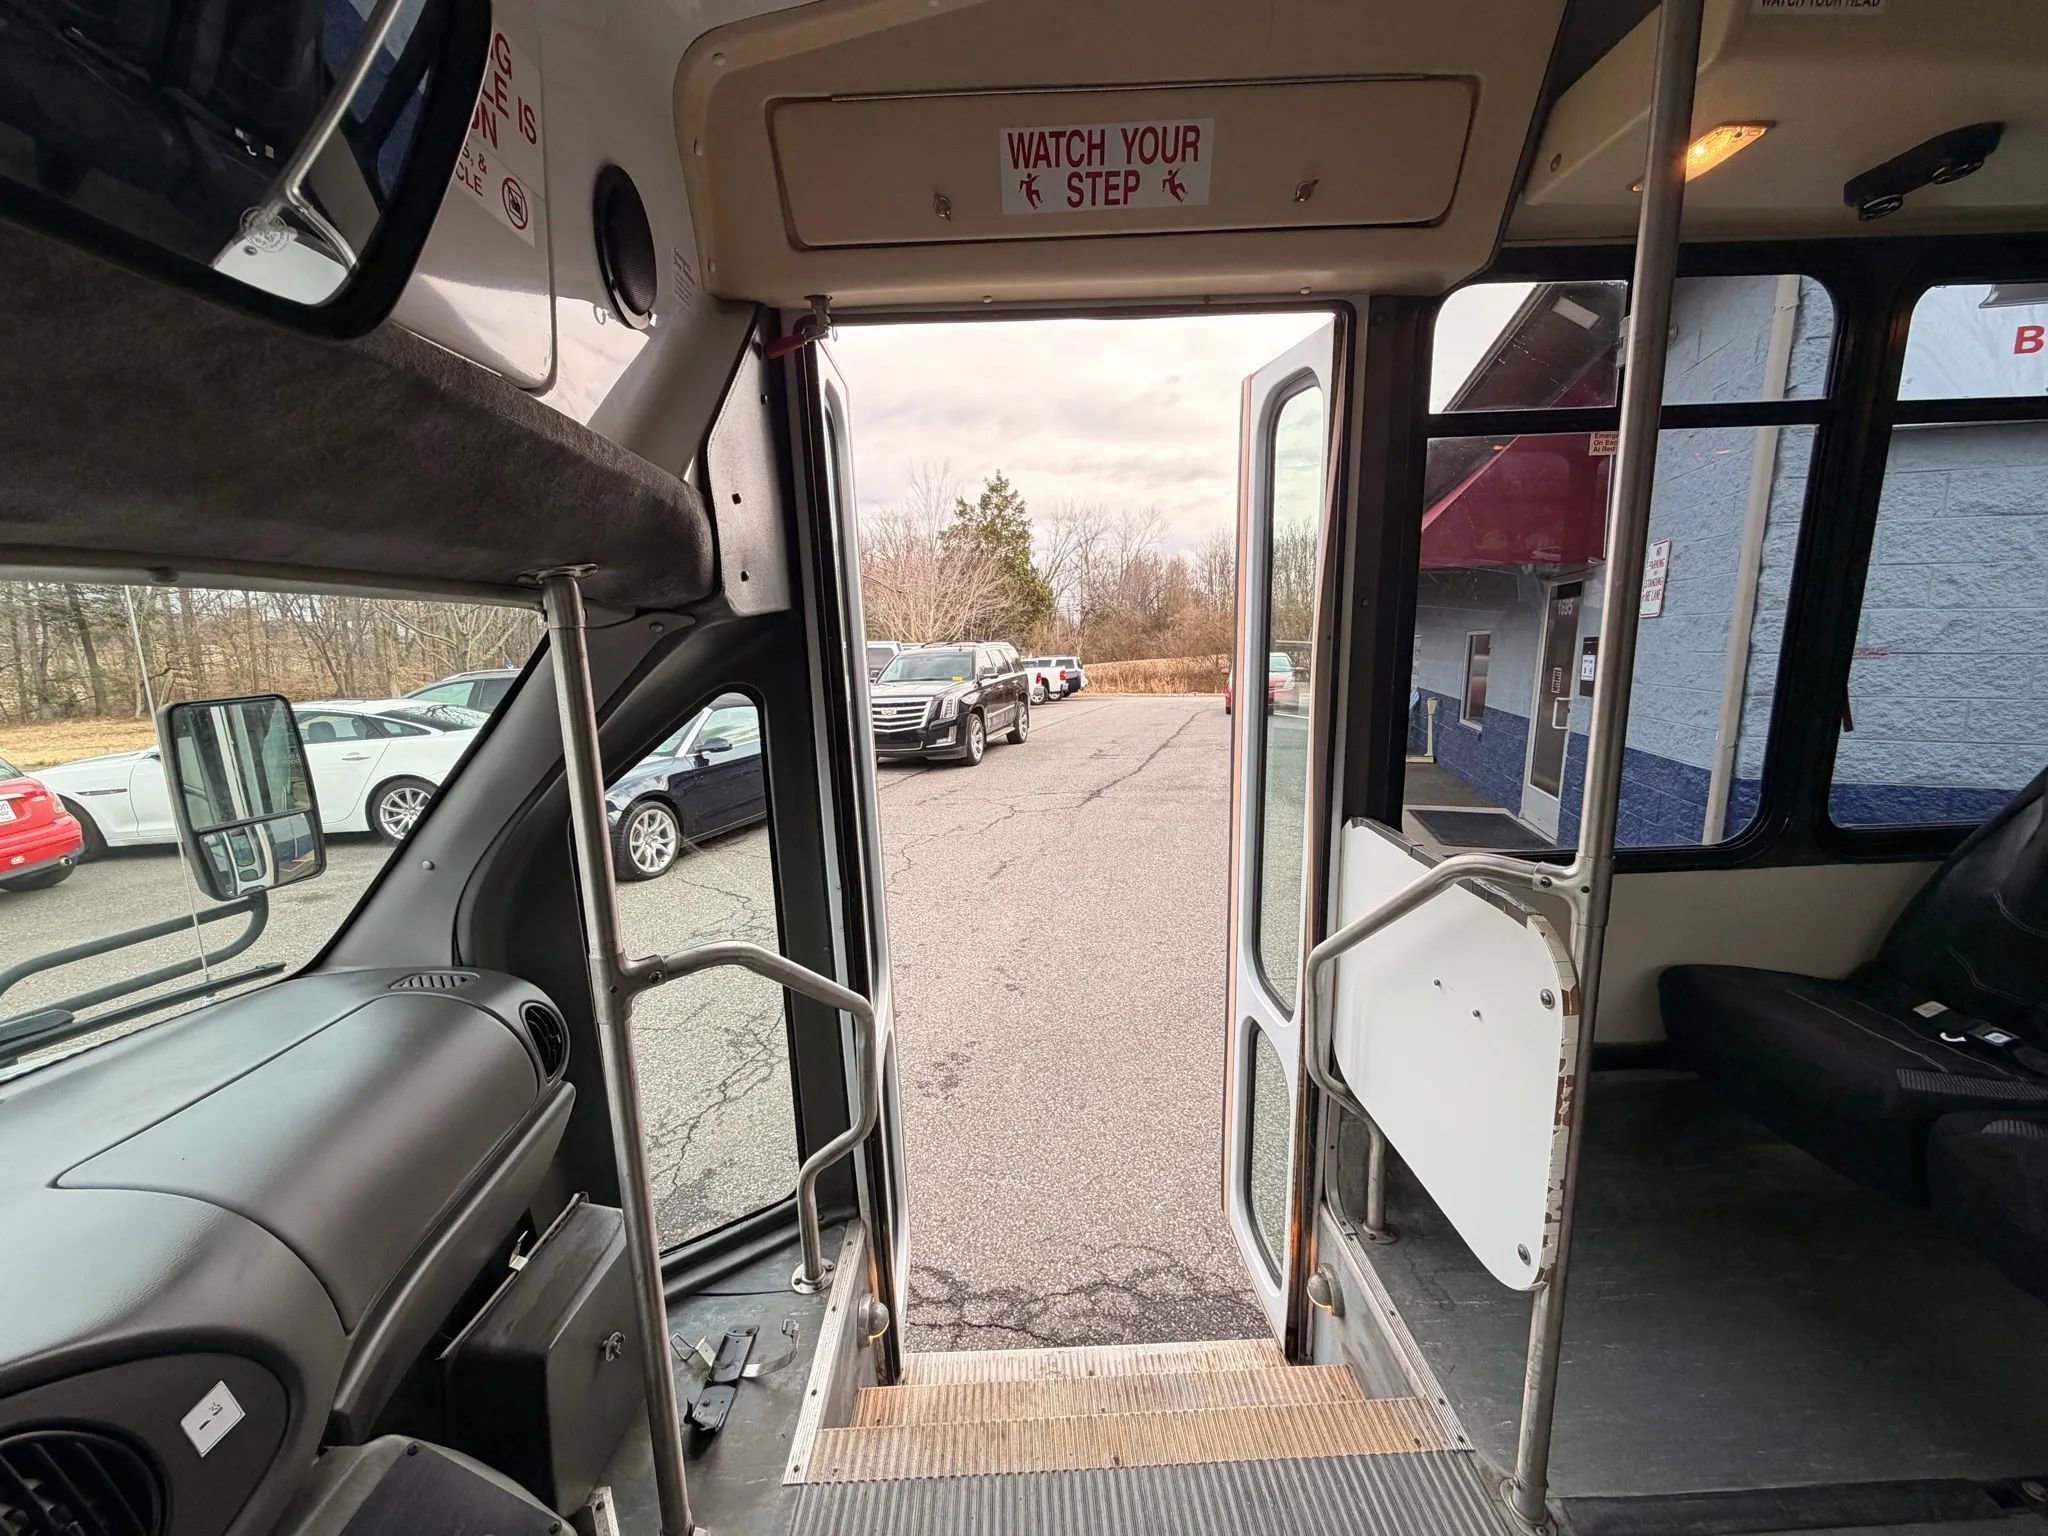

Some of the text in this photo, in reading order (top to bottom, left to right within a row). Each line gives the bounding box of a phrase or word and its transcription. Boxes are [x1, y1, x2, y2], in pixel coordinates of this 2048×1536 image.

[517, 95, 537, 145] IS
[478, 153, 487, 175] &
[1007, 125, 1200, 170] WATCH YOUR
[1066, 169, 1141, 208] STEP
[2013, 325, 2045, 354] B
[1644, 576, 1664, 588] STANDING
